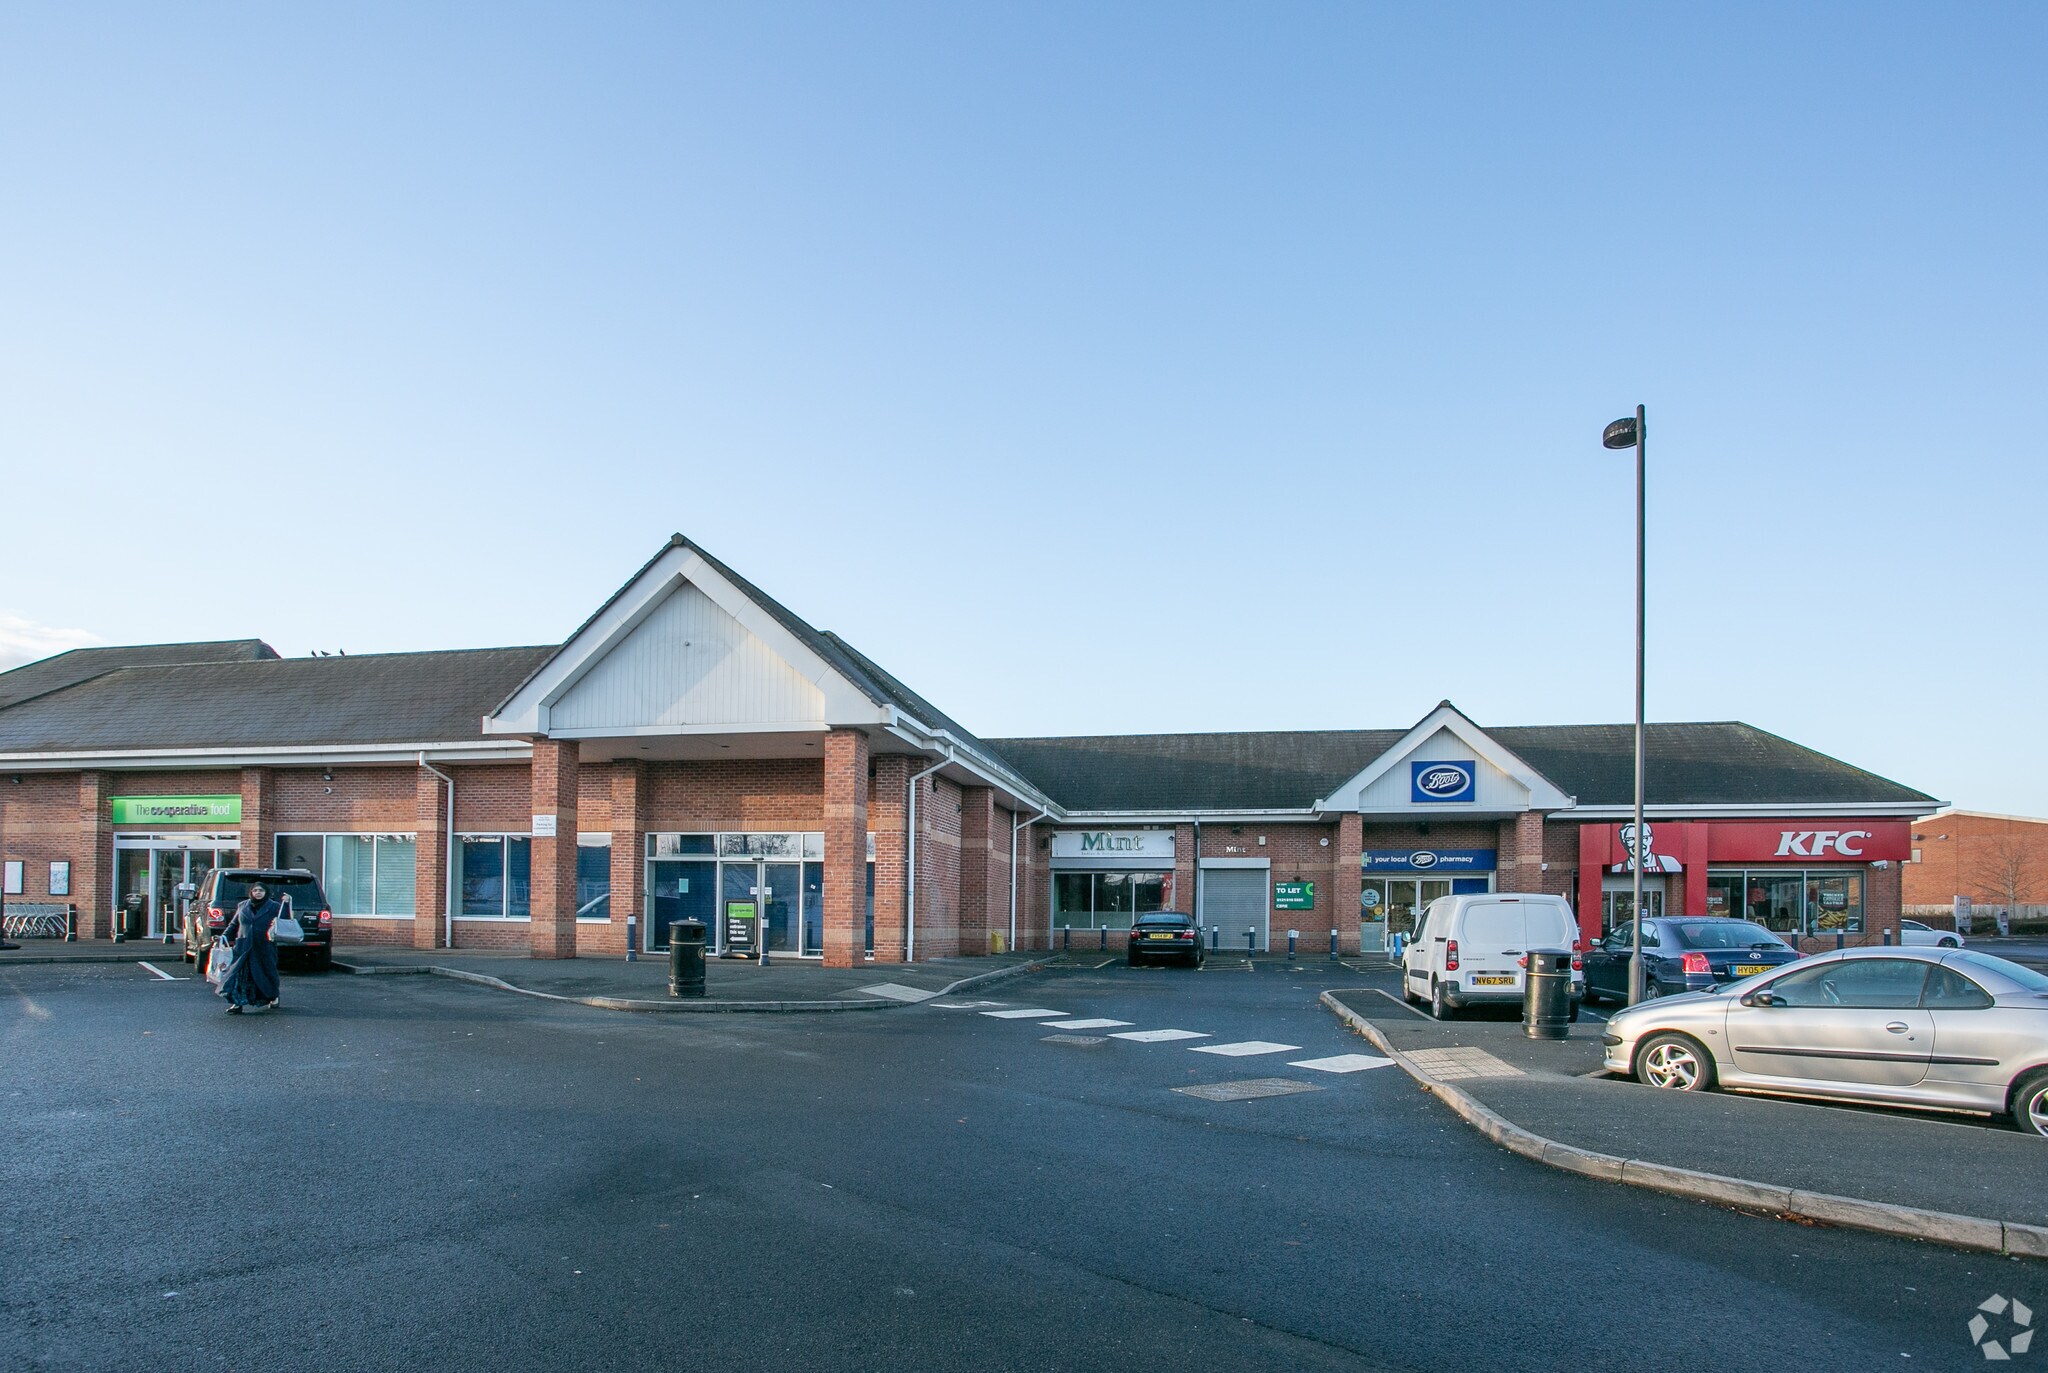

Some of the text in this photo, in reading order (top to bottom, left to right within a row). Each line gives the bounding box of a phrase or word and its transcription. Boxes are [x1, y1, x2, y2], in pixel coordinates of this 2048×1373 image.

[1426, 772, 1460, 789] Boots
[136, 804, 150, 815] The
[211, 803, 230, 815] food
[1081, 832, 1145, 851] Mint
[1774, 830, 1867, 856] KFC
[1226, 845, 1247, 853] Mint
[1440, 856, 1473, 864] pharmacy
[1737, 966, 1759, 974] HY05
[1476, 976, 1514, 985] NV67 SRU
